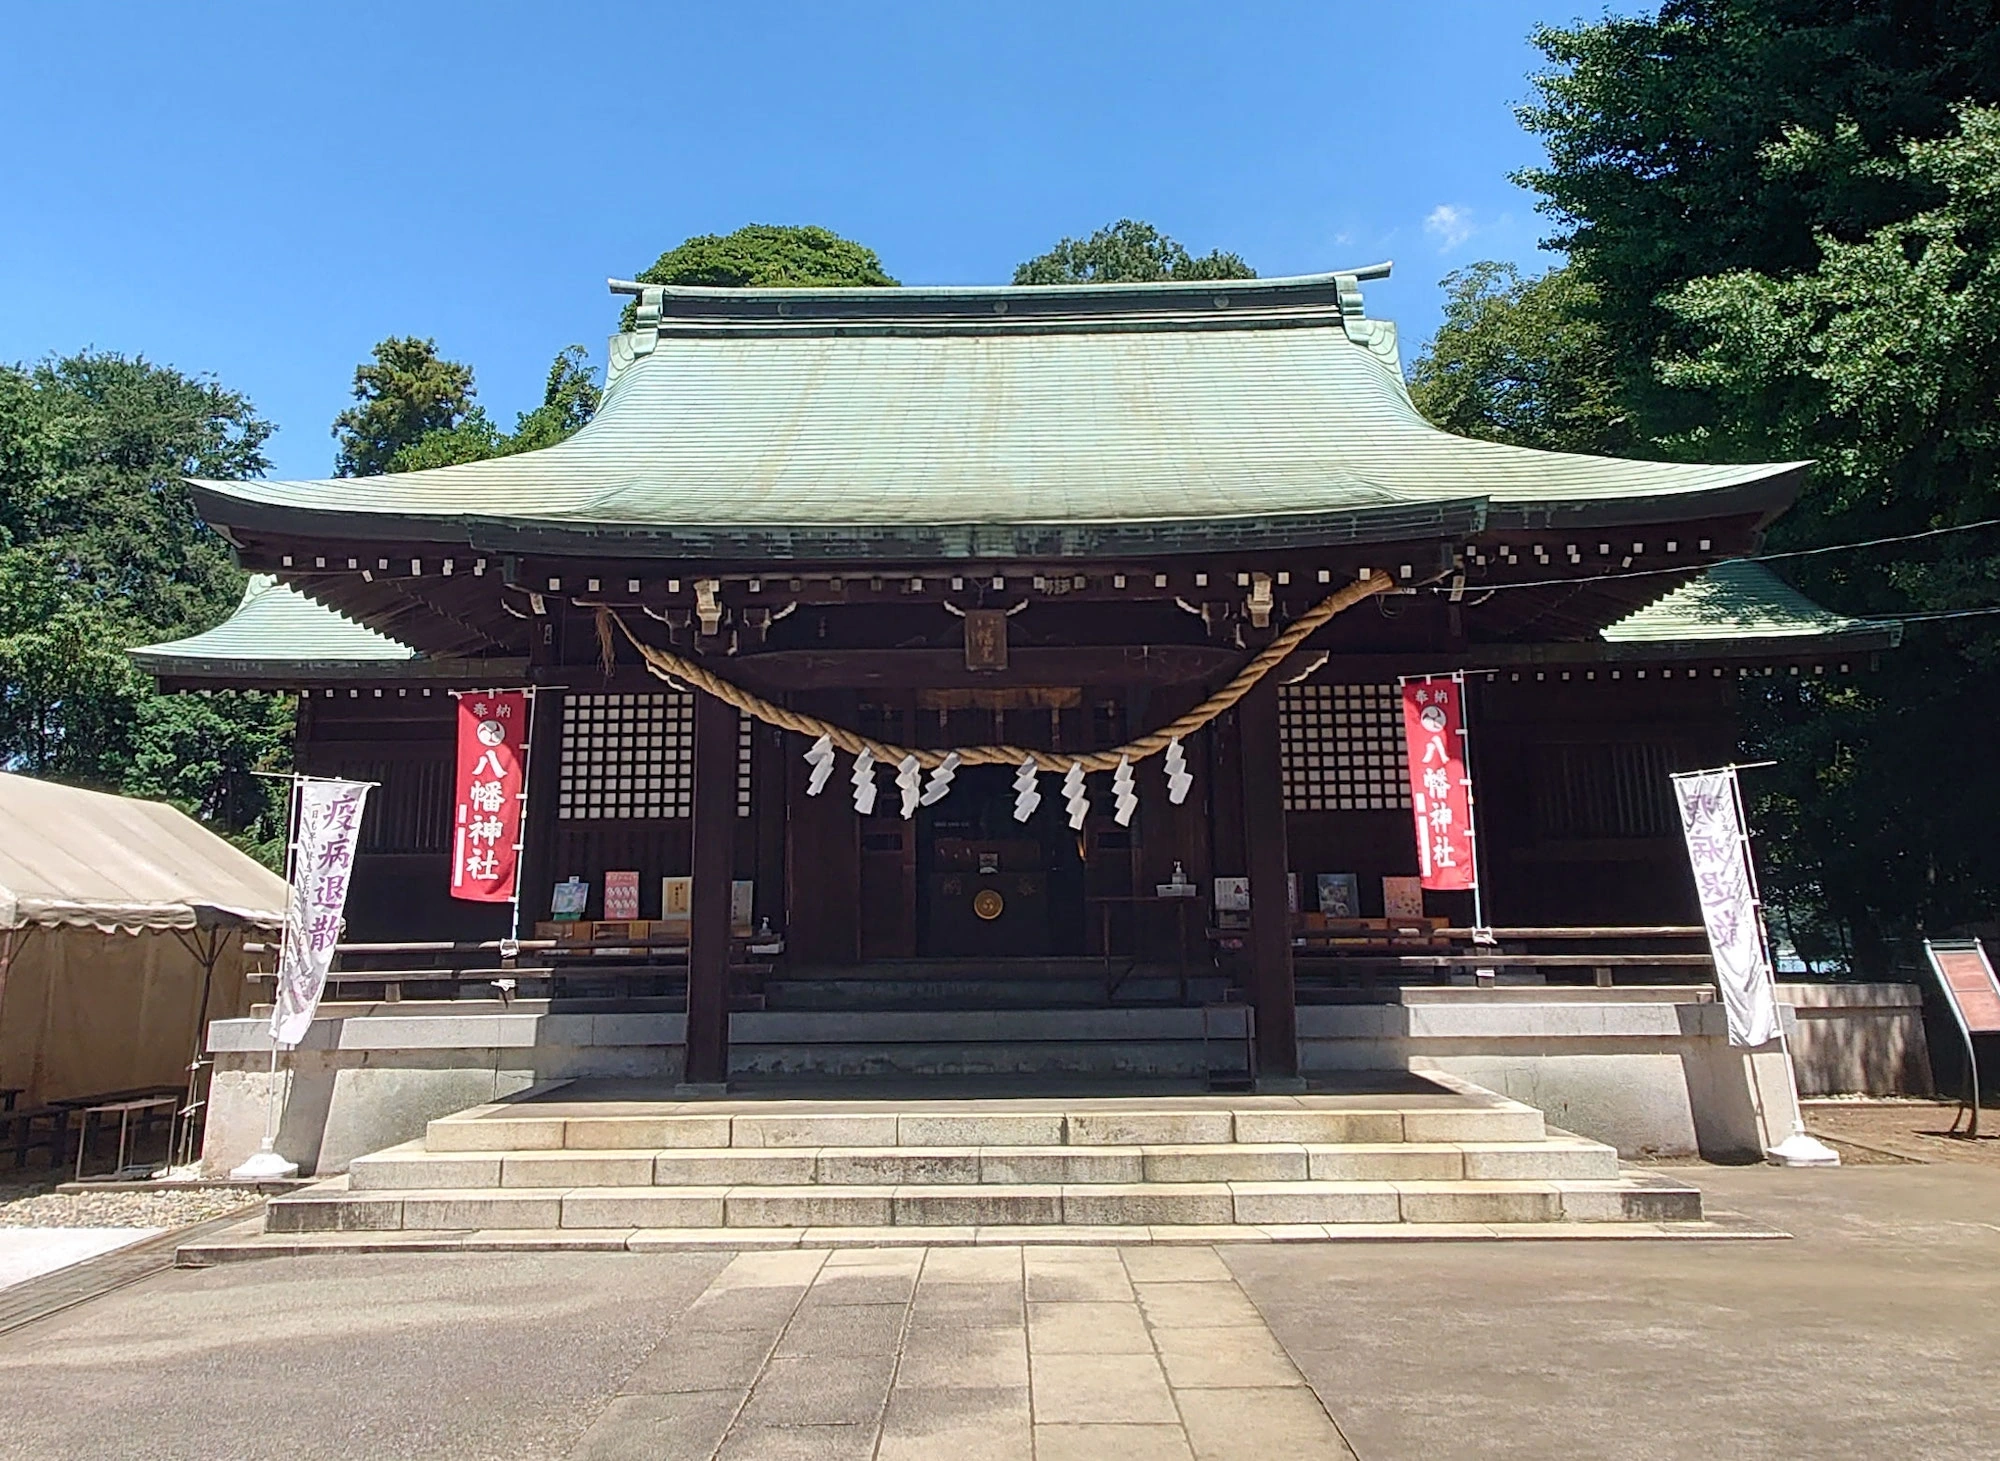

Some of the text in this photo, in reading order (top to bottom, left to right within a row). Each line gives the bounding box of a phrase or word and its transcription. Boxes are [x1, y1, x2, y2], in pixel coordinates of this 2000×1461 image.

[473, 702, 512, 719] 奉納
[1415, 689, 1449, 705] 奉納
[466, 749, 508, 881] 八幡神社
[1422, 735, 1457, 868] 八幡神社
[309, 794, 357, 951] 疫病退散
